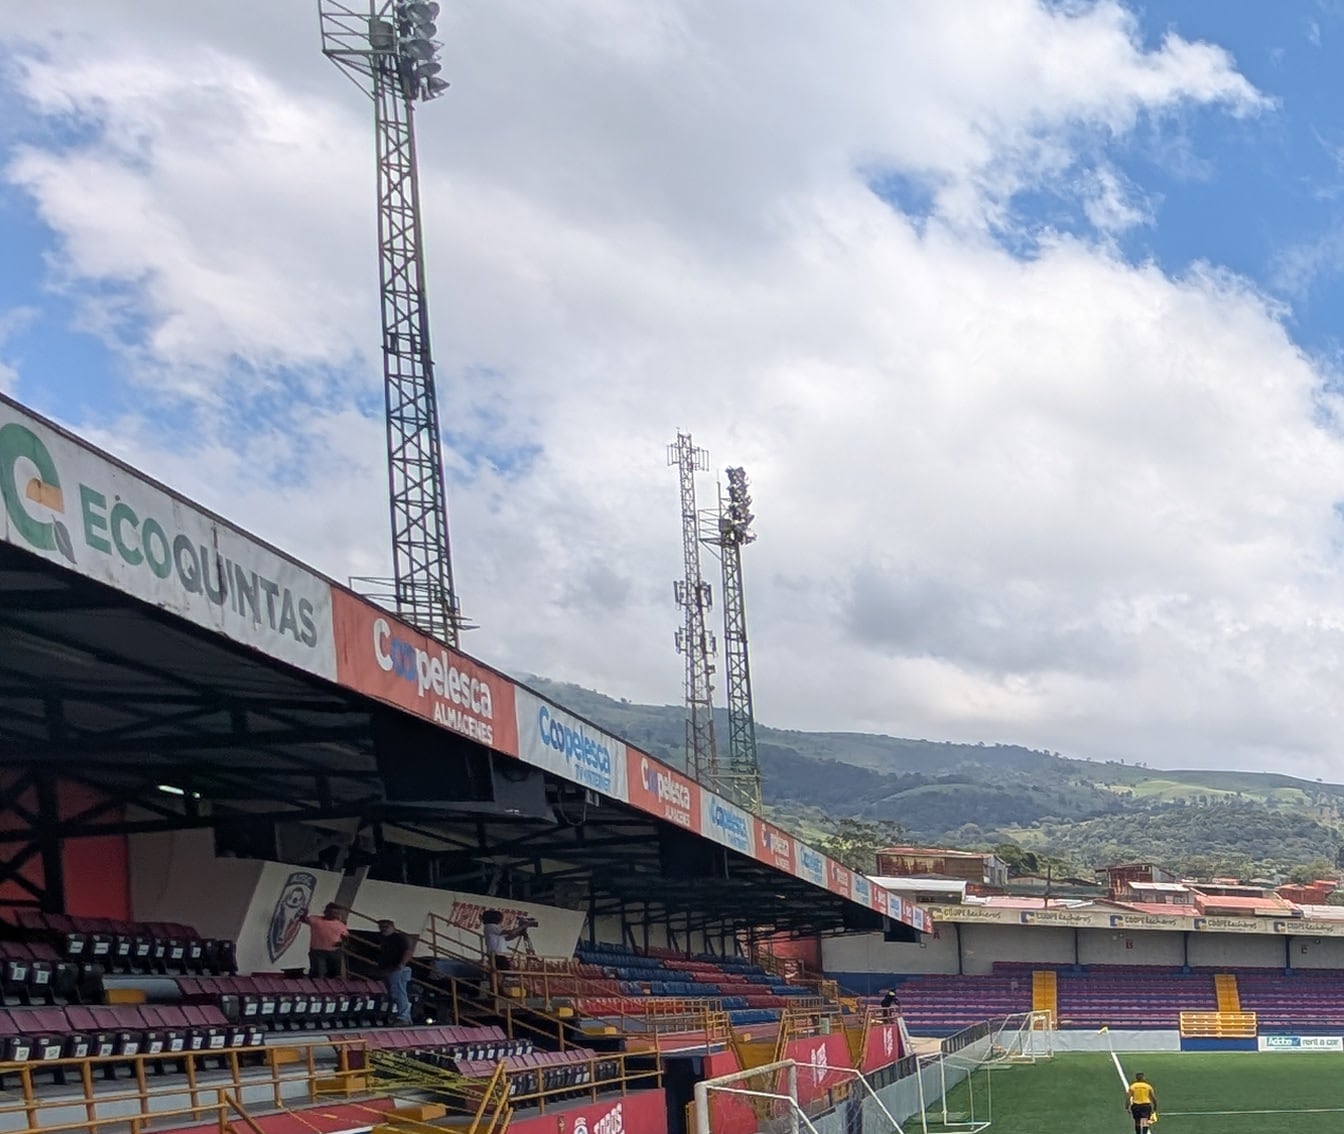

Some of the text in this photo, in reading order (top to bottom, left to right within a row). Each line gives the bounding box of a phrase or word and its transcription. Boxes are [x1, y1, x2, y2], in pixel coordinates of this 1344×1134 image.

[79, 483, 318, 648] ECOQUINTAS
[372, 617, 493, 720] Coopelesca
[433, 701, 494, 745] ALMACENES
[538, 705, 611, 775] Coopelesca
[640, 756, 691, 810] Coopelesca
